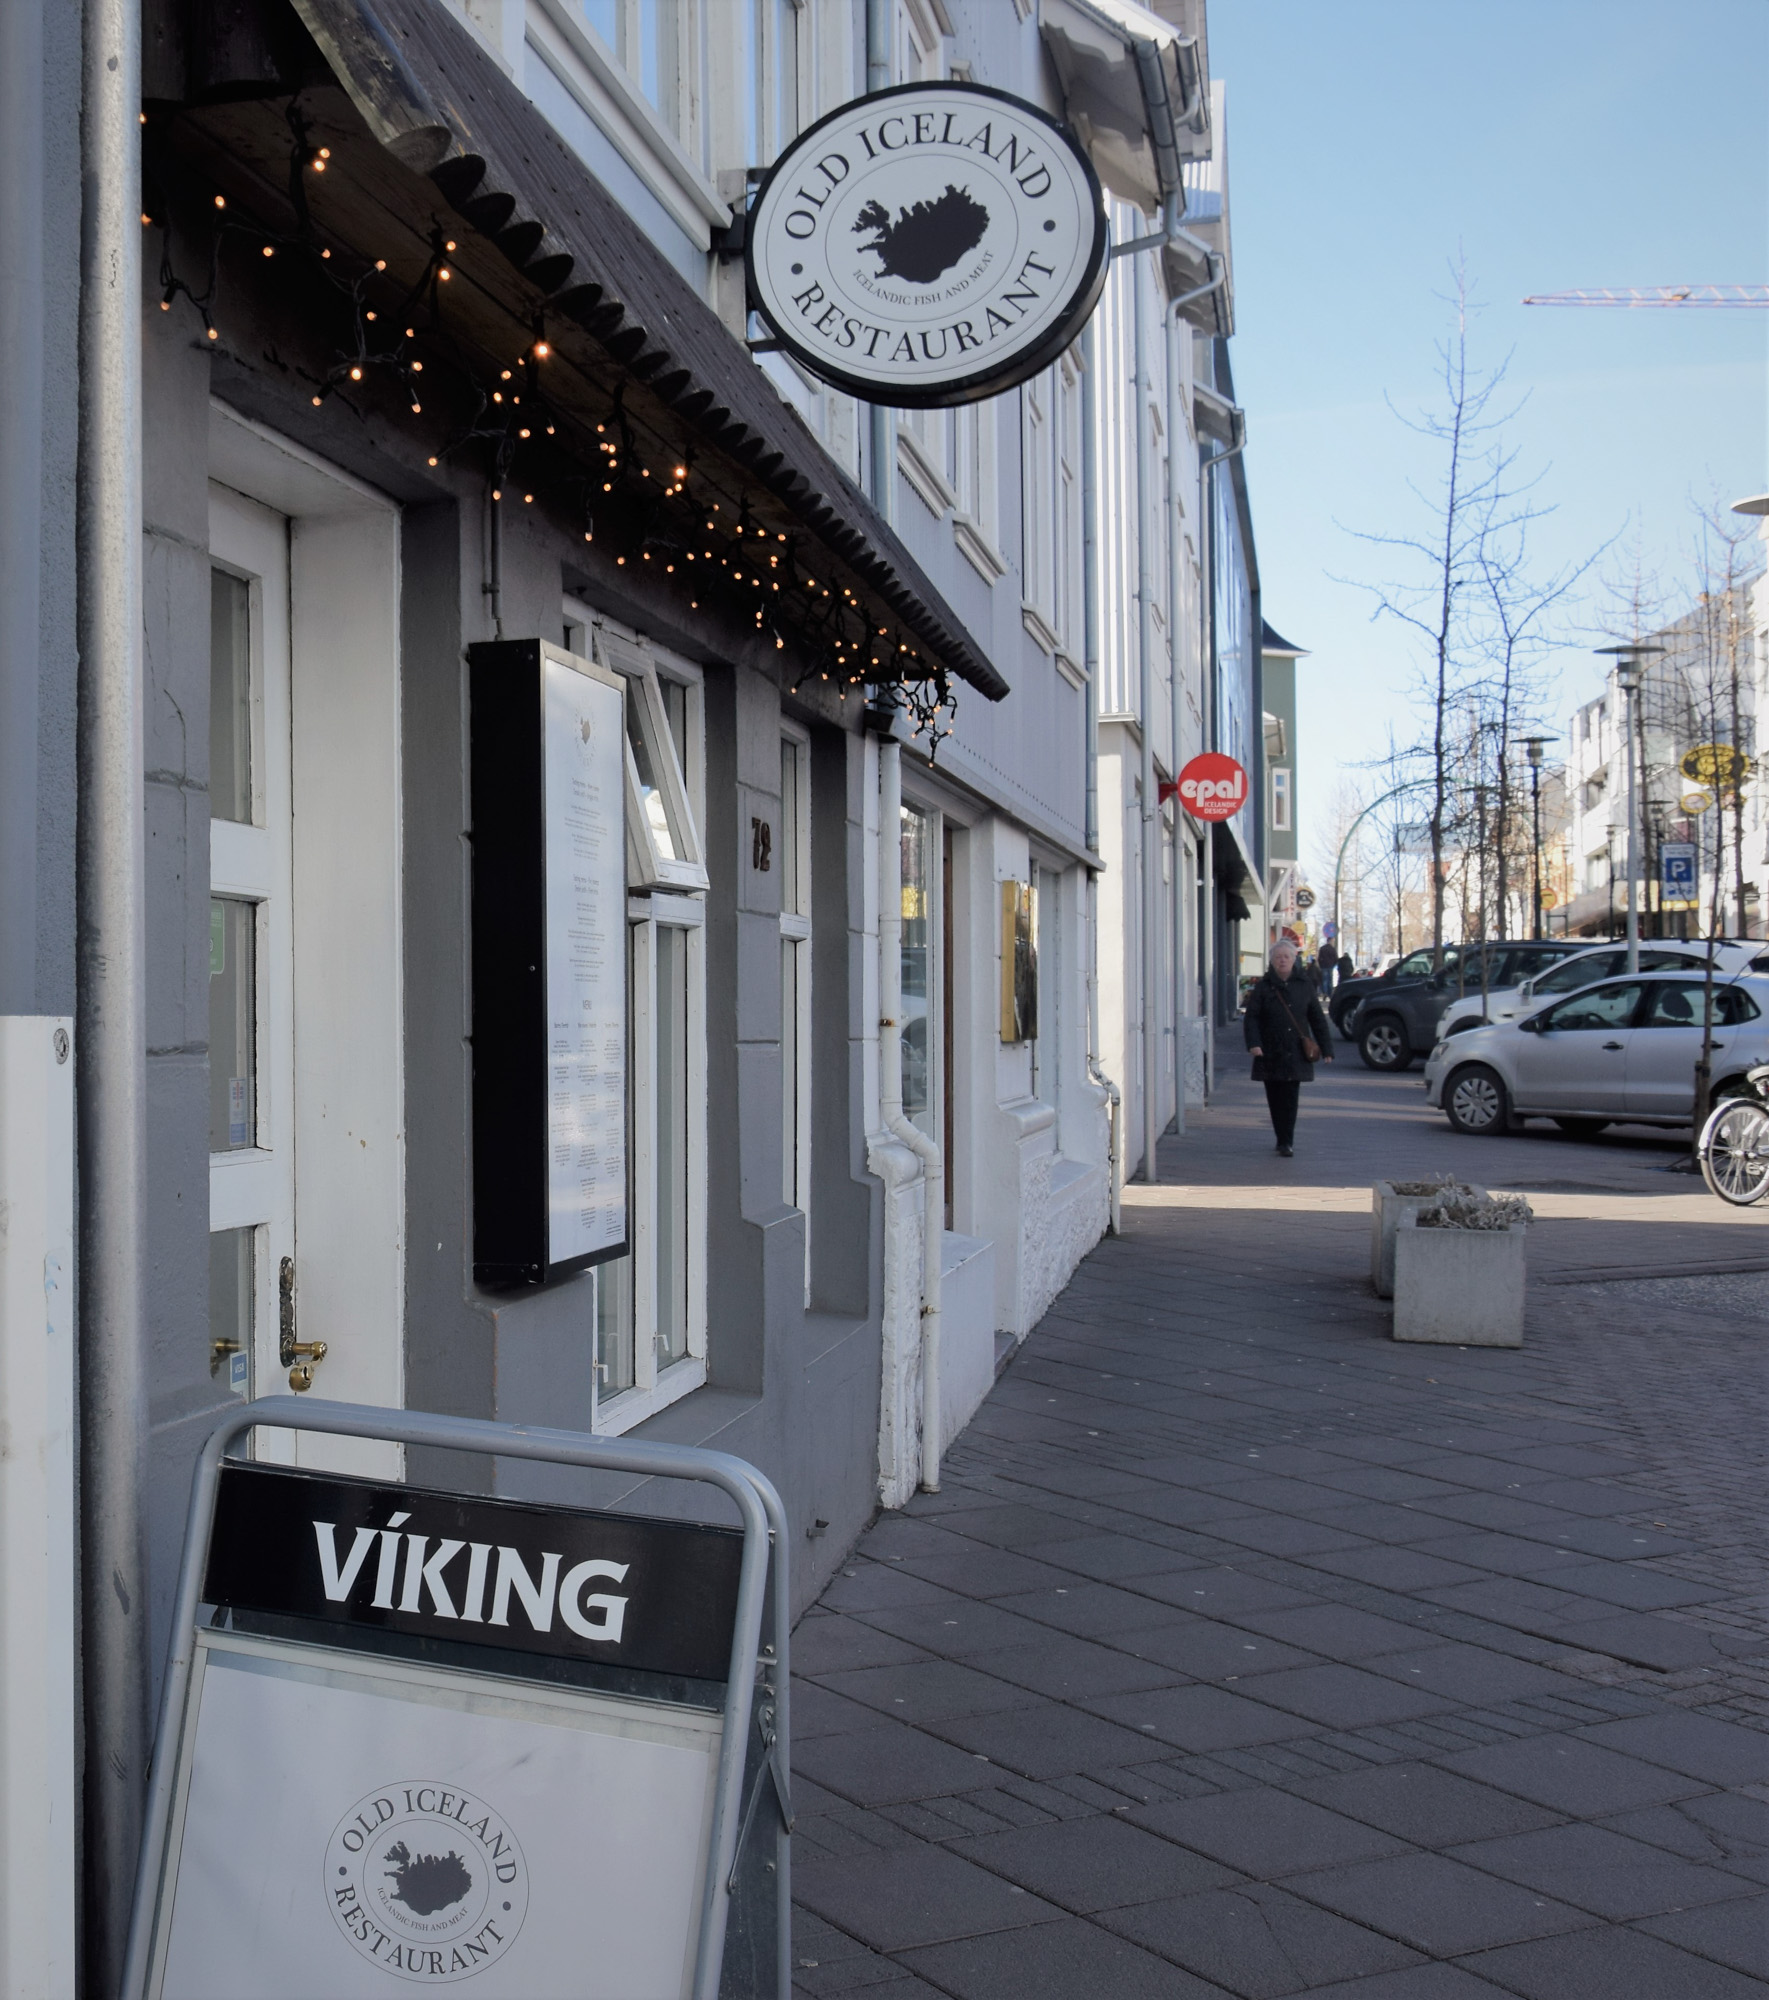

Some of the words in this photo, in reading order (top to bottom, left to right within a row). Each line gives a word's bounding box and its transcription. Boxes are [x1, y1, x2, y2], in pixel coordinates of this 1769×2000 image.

[784, 152, 851, 241] OLD
[856, 112, 1053, 200] ICELAND
[791, 250, 1057, 363] RESTAURANT
[852, 268, 912, 306] ICELANDIC
[914, 292, 942, 306] FISH
[945, 280, 971, 299] AND
[969, 250, 995, 282] MEAT
[1180, 770, 1243, 808] epal
[1204, 801, 1237, 809] ICELANDIC
[1671, 861, 1686, 879] P
[311, 1511, 631, 1644] VÍKING
[342, 1797, 395, 1853] OLD
[402, 1788, 518, 1884] ICELAND
[333, 1882, 505, 1975] RESTAURANT
[377, 1886, 409, 1926] ICELANDIC
[410, 1920, 429, 1932] FISH
[430, 1921, 448, 1932] AND
[448, 1906, 469, 1926] MEAT
